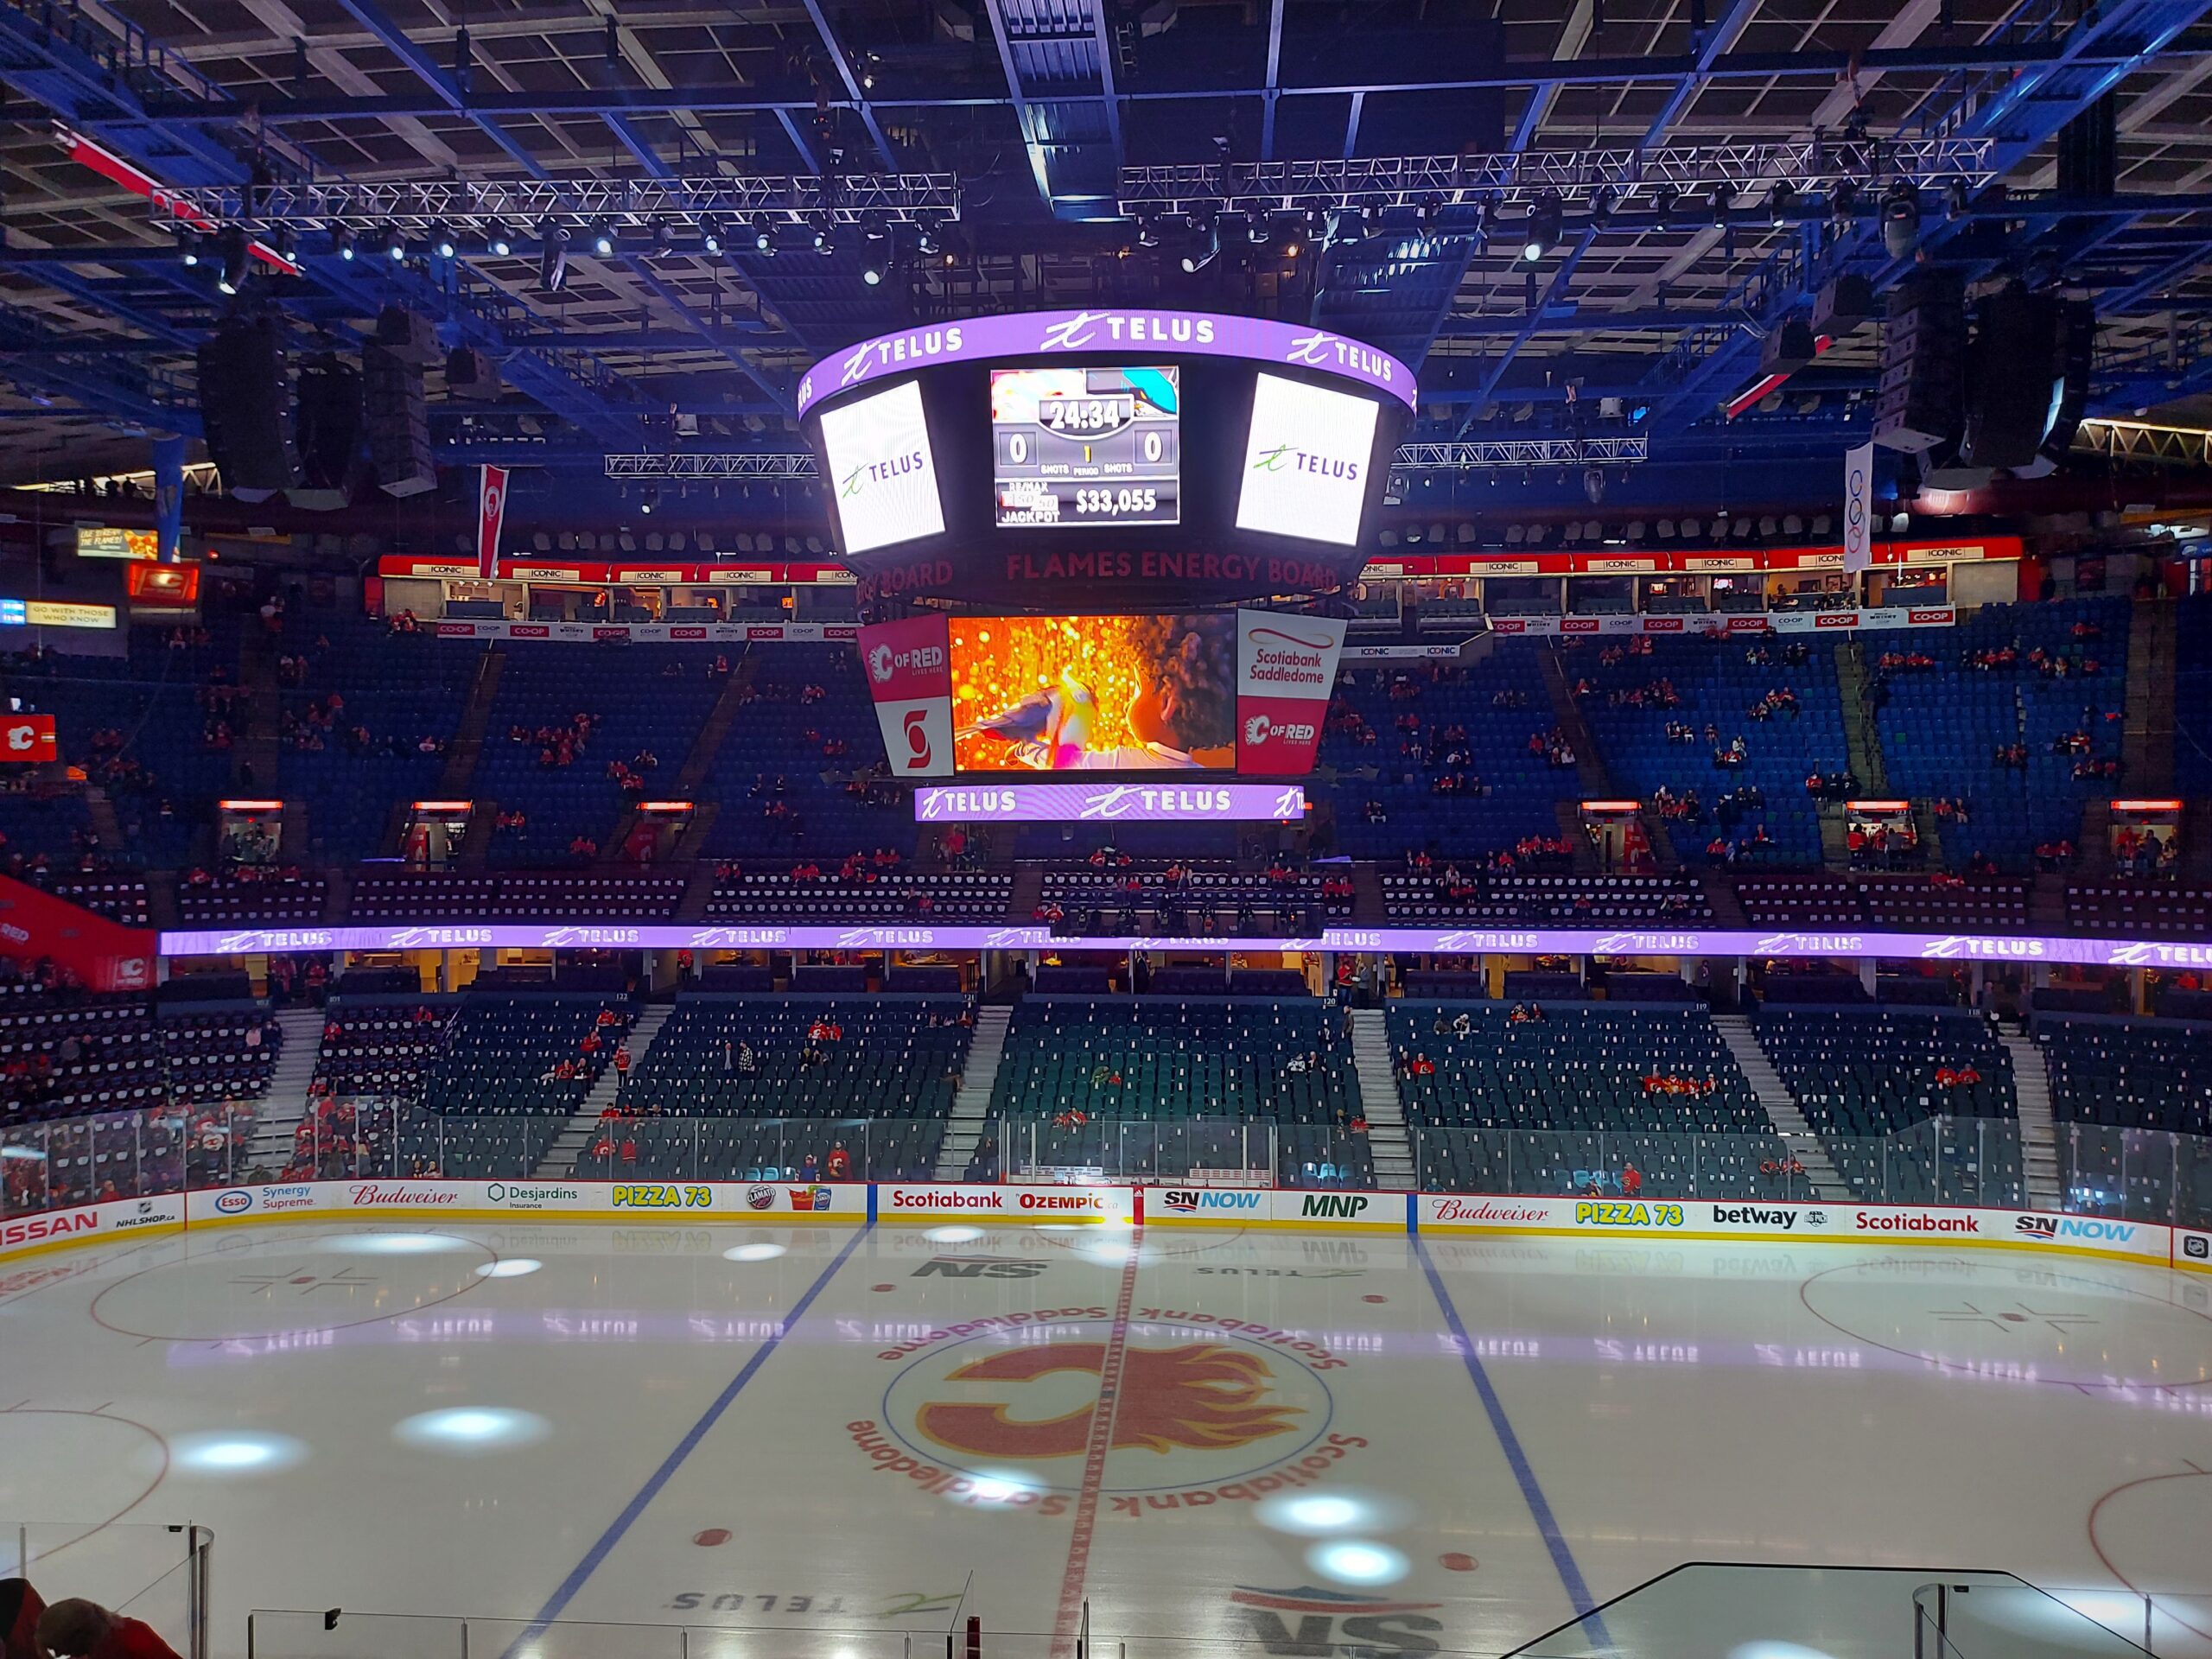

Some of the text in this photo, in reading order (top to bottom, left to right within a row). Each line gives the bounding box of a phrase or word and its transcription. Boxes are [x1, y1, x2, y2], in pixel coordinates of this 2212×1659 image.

[1107, 317, 1214, 343] TELUS
[878, 327, 963, 365] TELUS
[1335, 343, 1392, 382] TELUS
[1050, 400, 1120, 429] 24:34
[1009, 433, 1028, 463] 0
[1144, 431, 1162, 462] 0
[869, 451, 924, 484] TELUS
[1296, 452, 1357, 480] TELUS
[1076, 489, 1157, 516] $33,055
[1001, 511, 1060, 523] JACKPOT
[1007, 551, 1338, 588] FLAMES ENERGY BOARD
[894, 653, 910, 668] OF
[912, 646, 943, 669] RED
[1256, 649, 1322, 668] Scotiabank
[1250, 665, 1324, 683] Saddledome
[1270, 725, 1285, 737] OF
[1286, 723, 1314, 740] RED
[945, 791, 1016, 811] TELUS
[1141, 791, 1231, 810] TELUS
[261, 931, 333, 947] TELUS
[428, 929, 493, 943] TELUS
[580, 930, 639, 943] TELUS
[726, 930, 786, 944] TELUS
[873, 930, 934, 944] TELUS
[1321, 932, 1382, 946] TELUS
[1473, 934, 1538, 947] TELUS
[1633, 936, 1699, 949] TELUS
[1796, 937, 1862, 950] TELUS
[1966, 938, 2044, 955] TELUS
[221, 1195, 248, 1207] Esso
[263, 1185, 312, 1199] Synergy
[349, 1184, 459, 1206] Budweiser
[510, 1185, 578, 1203] Desjardins
[612, 1185, 711, 1208] PIZZA 73
[747, 1188, 776, 1203] CLAMATO
[893, 1191, 1003, 1209] Scotiabank
[1164, 1192, 1261, 1208] SN NOW
[263, 1197, 314, 1209] Supreme
[1302, 1194, 1369, 1217] MNP
[1432, 1198, 1549, 1222] Budweiser
[1576, 1203, 1684, 1227] PIZZA 73
[1713, 1205, 1797, 1229] betway
[1856, 1212, 1979, 1232] Scotiabank
[0, 1211, 98, 1246] ISSAN
[2015, 1216, 2136, 1243] SN NOW
[1197, 1267, 1303, 1277] TELUS
[878, 1306, 1348, 1370] Scotiabank Saddledome
[1109, 1433, 1369, 1516] Scotiabank
[671, 1592, 847, 1614] TELUS
